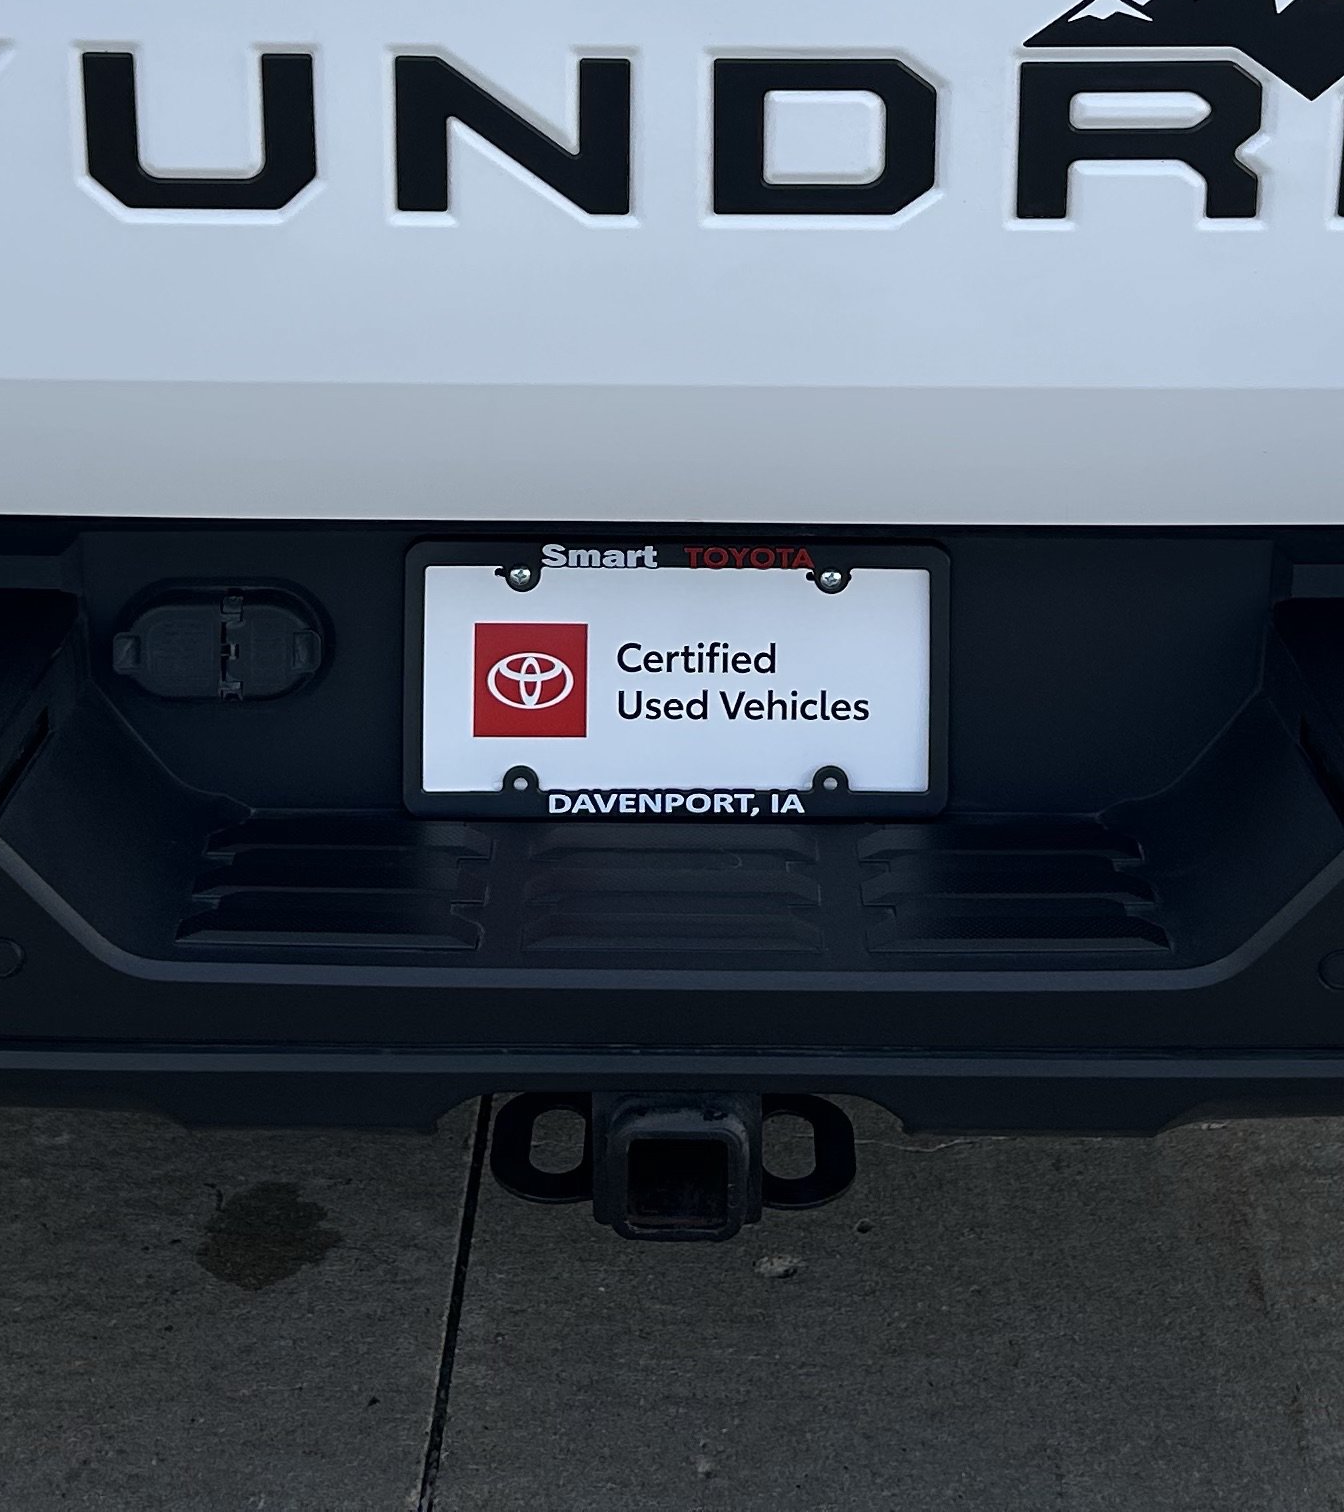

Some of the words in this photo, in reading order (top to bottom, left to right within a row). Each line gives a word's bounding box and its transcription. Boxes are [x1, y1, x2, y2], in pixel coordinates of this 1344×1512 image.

[541, 543, 658, 568] Smart
[683, 546, 815, 570] TOYOTA
[616, 642, 777, 674] Certified
[618, 690, 708, 720] Used
[720, 690, 870, 721] Vehicles
[548, 792, 760, 816] DAVENPORT,
[770, 793, 805, 814] IA
